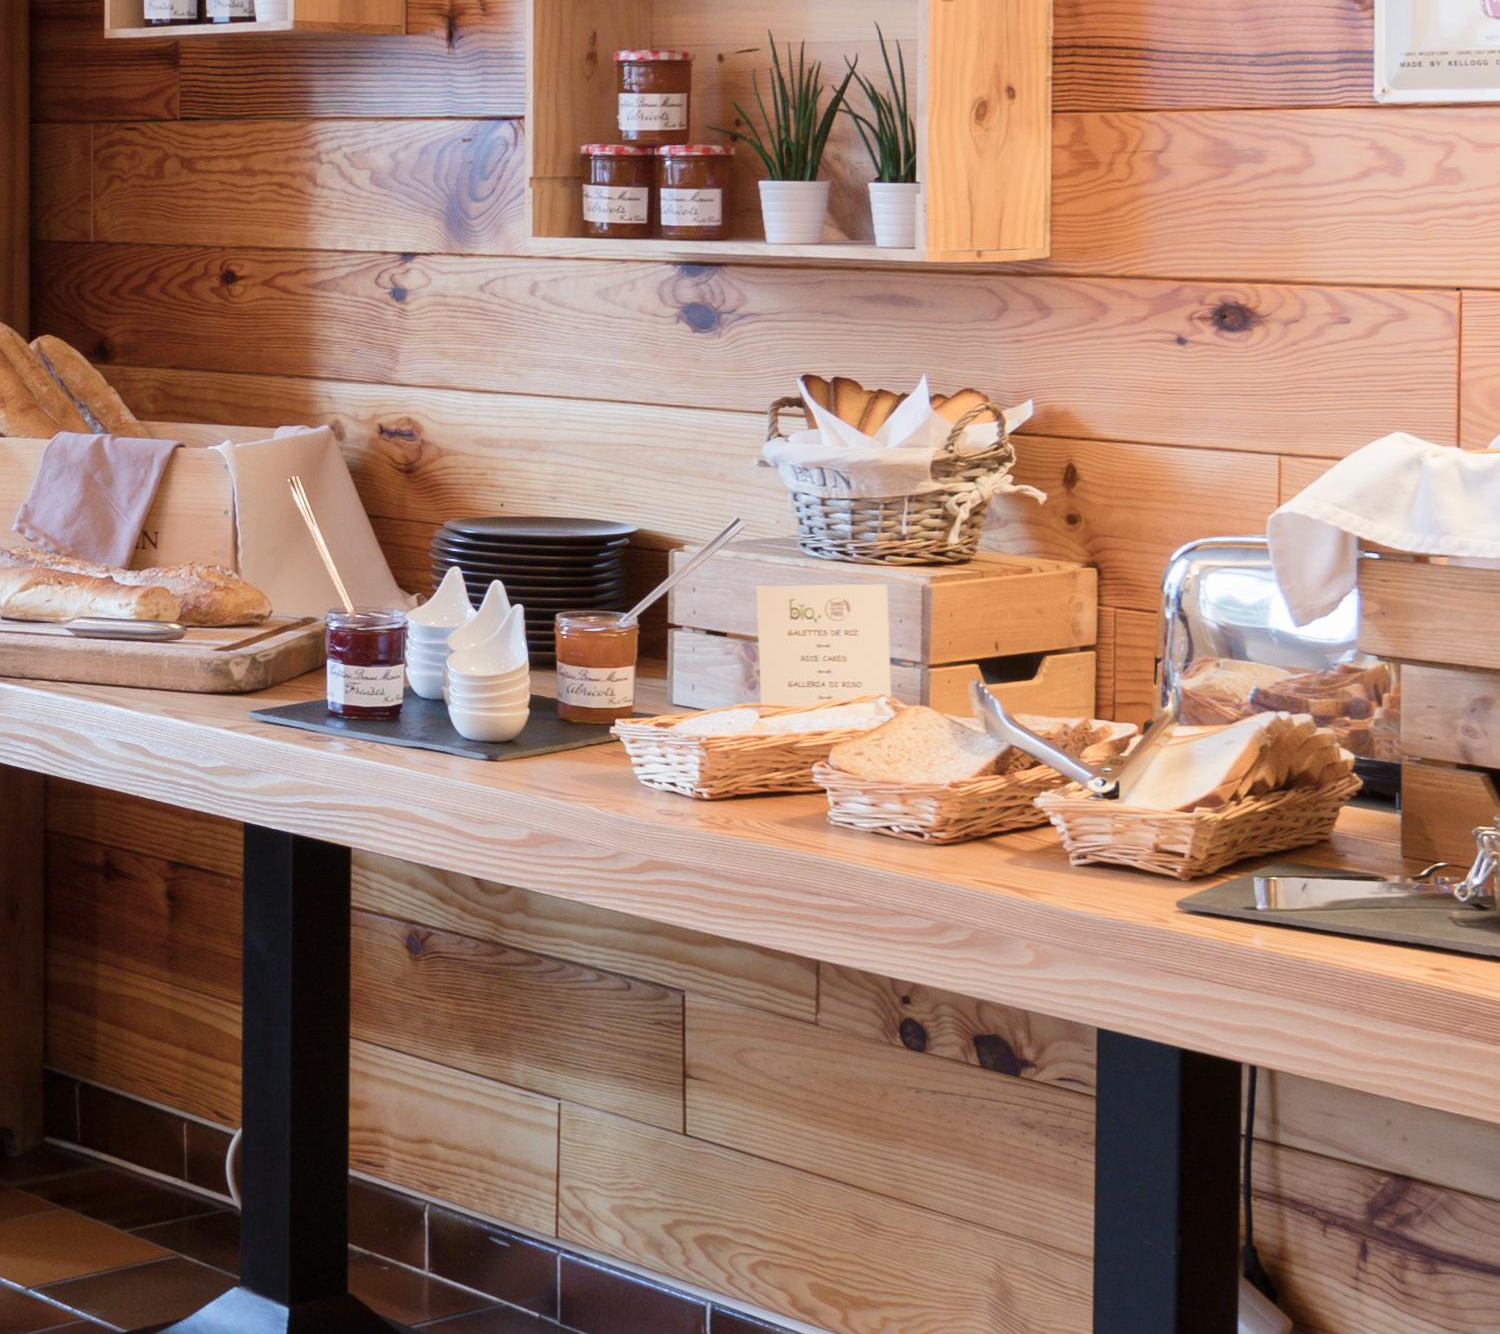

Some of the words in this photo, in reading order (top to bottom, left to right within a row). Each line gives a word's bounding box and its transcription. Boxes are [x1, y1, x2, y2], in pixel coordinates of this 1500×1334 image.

[1447, 58, 1489, 67] KELLOGG
[787, 629, 828, 637] GALETTES
[831, 629, 841, 637] DE
[800, 655, 819, 663] RICE
[822, 655, 847, 663] CAKES
